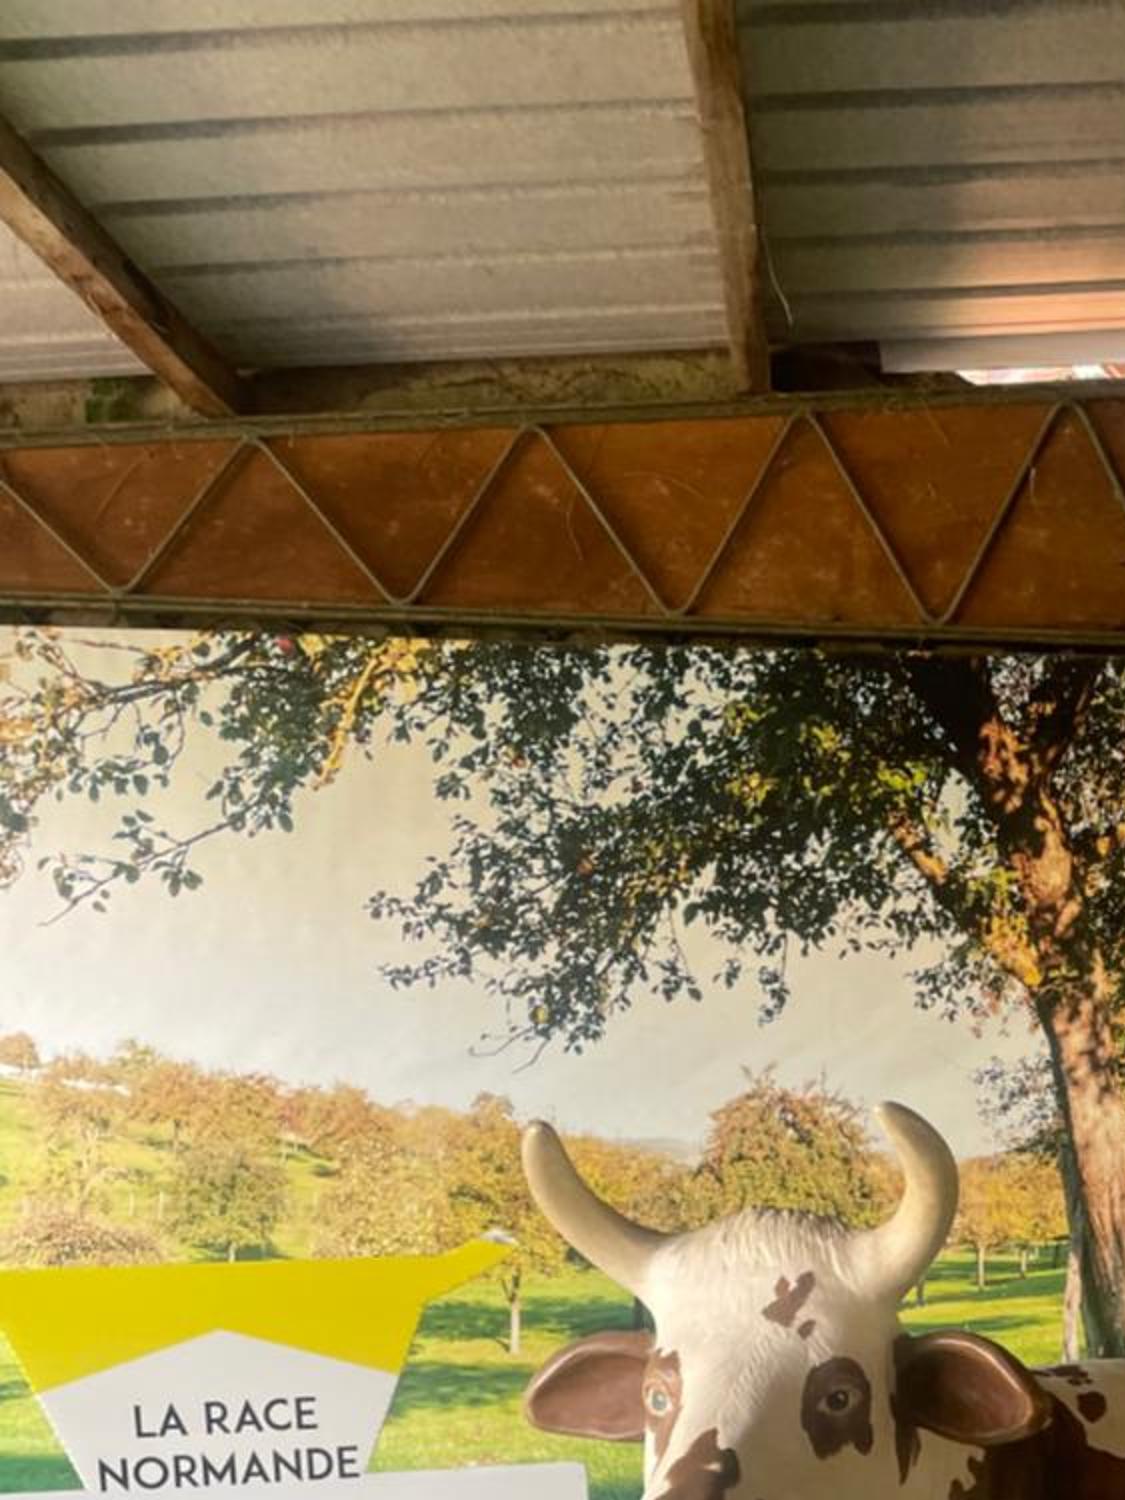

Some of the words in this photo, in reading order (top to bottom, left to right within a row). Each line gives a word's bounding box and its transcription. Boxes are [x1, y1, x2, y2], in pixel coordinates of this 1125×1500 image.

[133, 1403, 188, 1438] LA
[204, 1396, 319, 1435] RACE
[98, 1445, 361, 1492] NORMANDE
